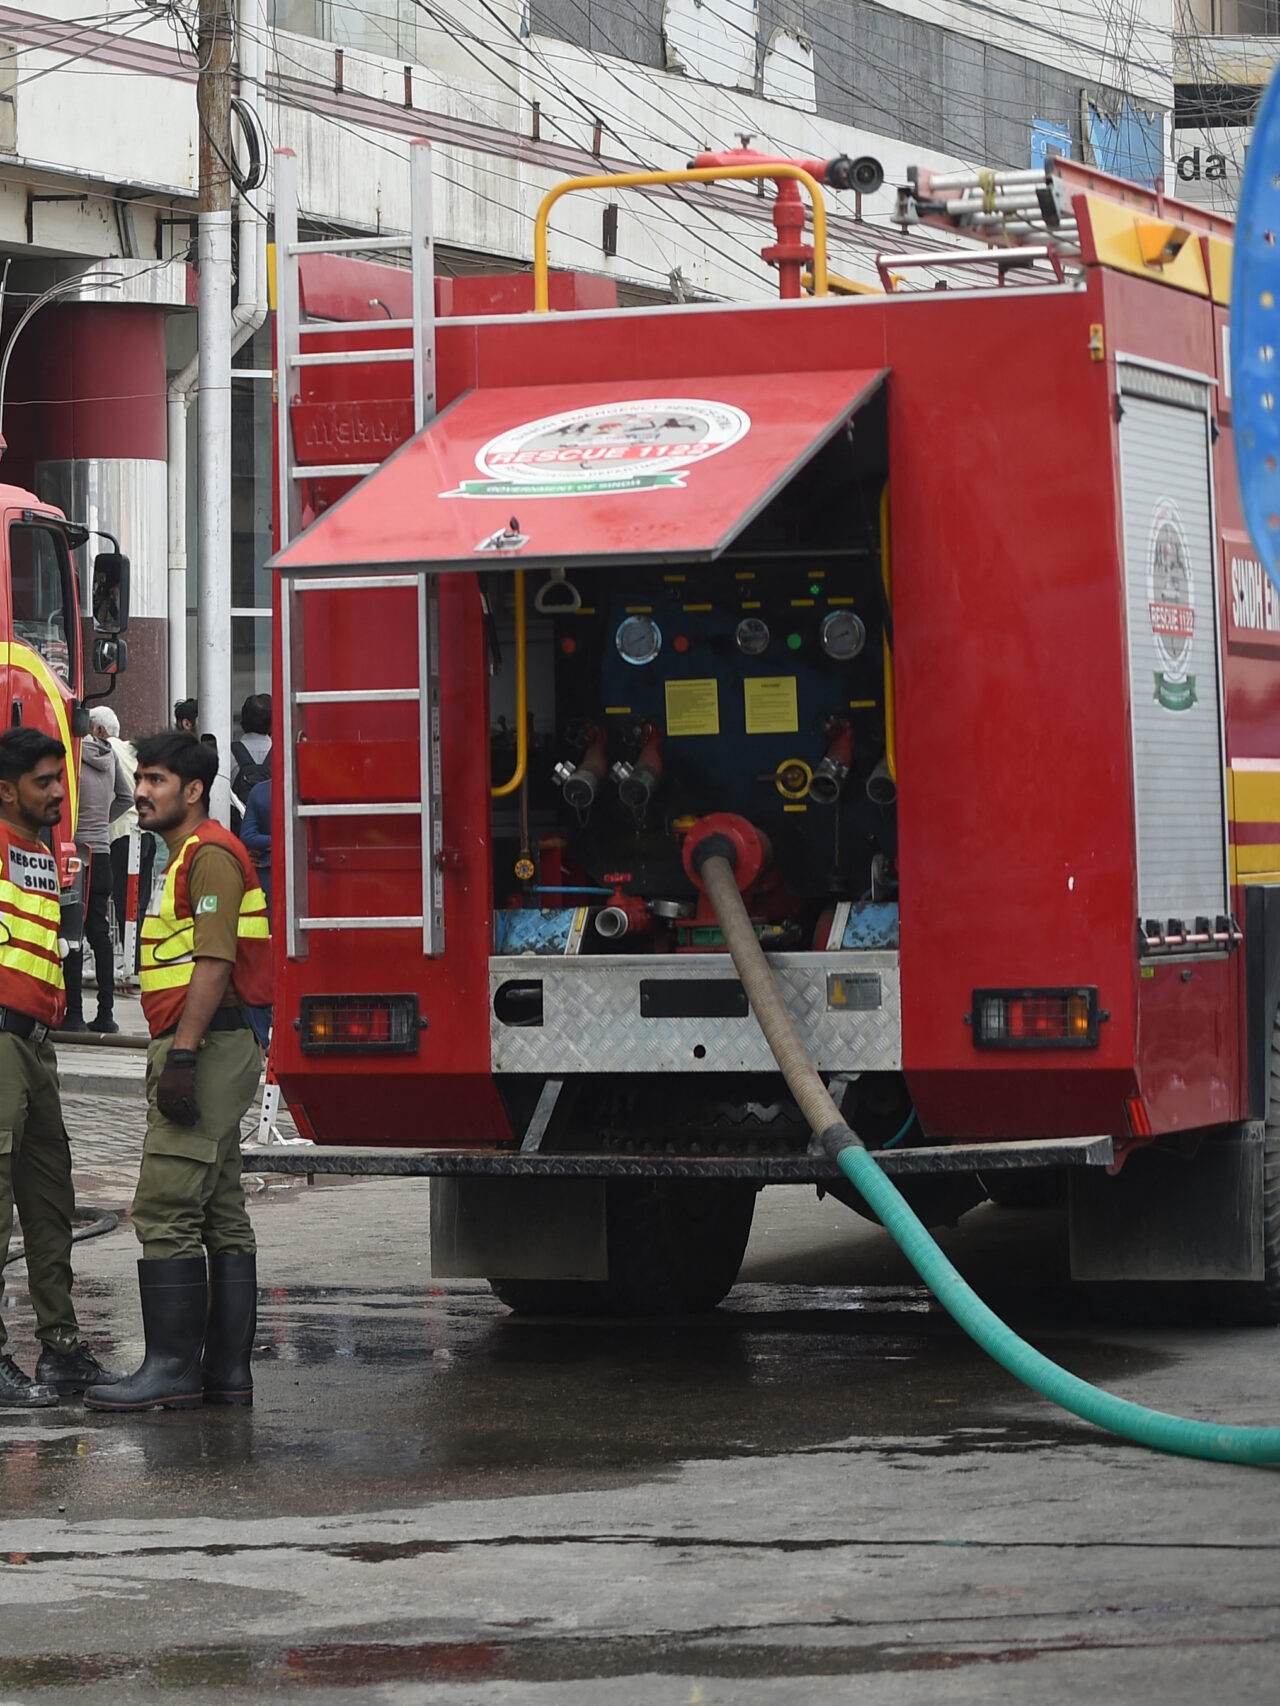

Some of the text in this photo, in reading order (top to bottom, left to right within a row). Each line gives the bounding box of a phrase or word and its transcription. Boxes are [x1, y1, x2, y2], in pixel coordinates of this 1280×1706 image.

[1177, 147, 1226, 181] da
[489, 443, 710, 465] RESCUE 1122
[1231, 557, 1264, 630] SINDH
[10, 849, 55, 872] RESCUE
